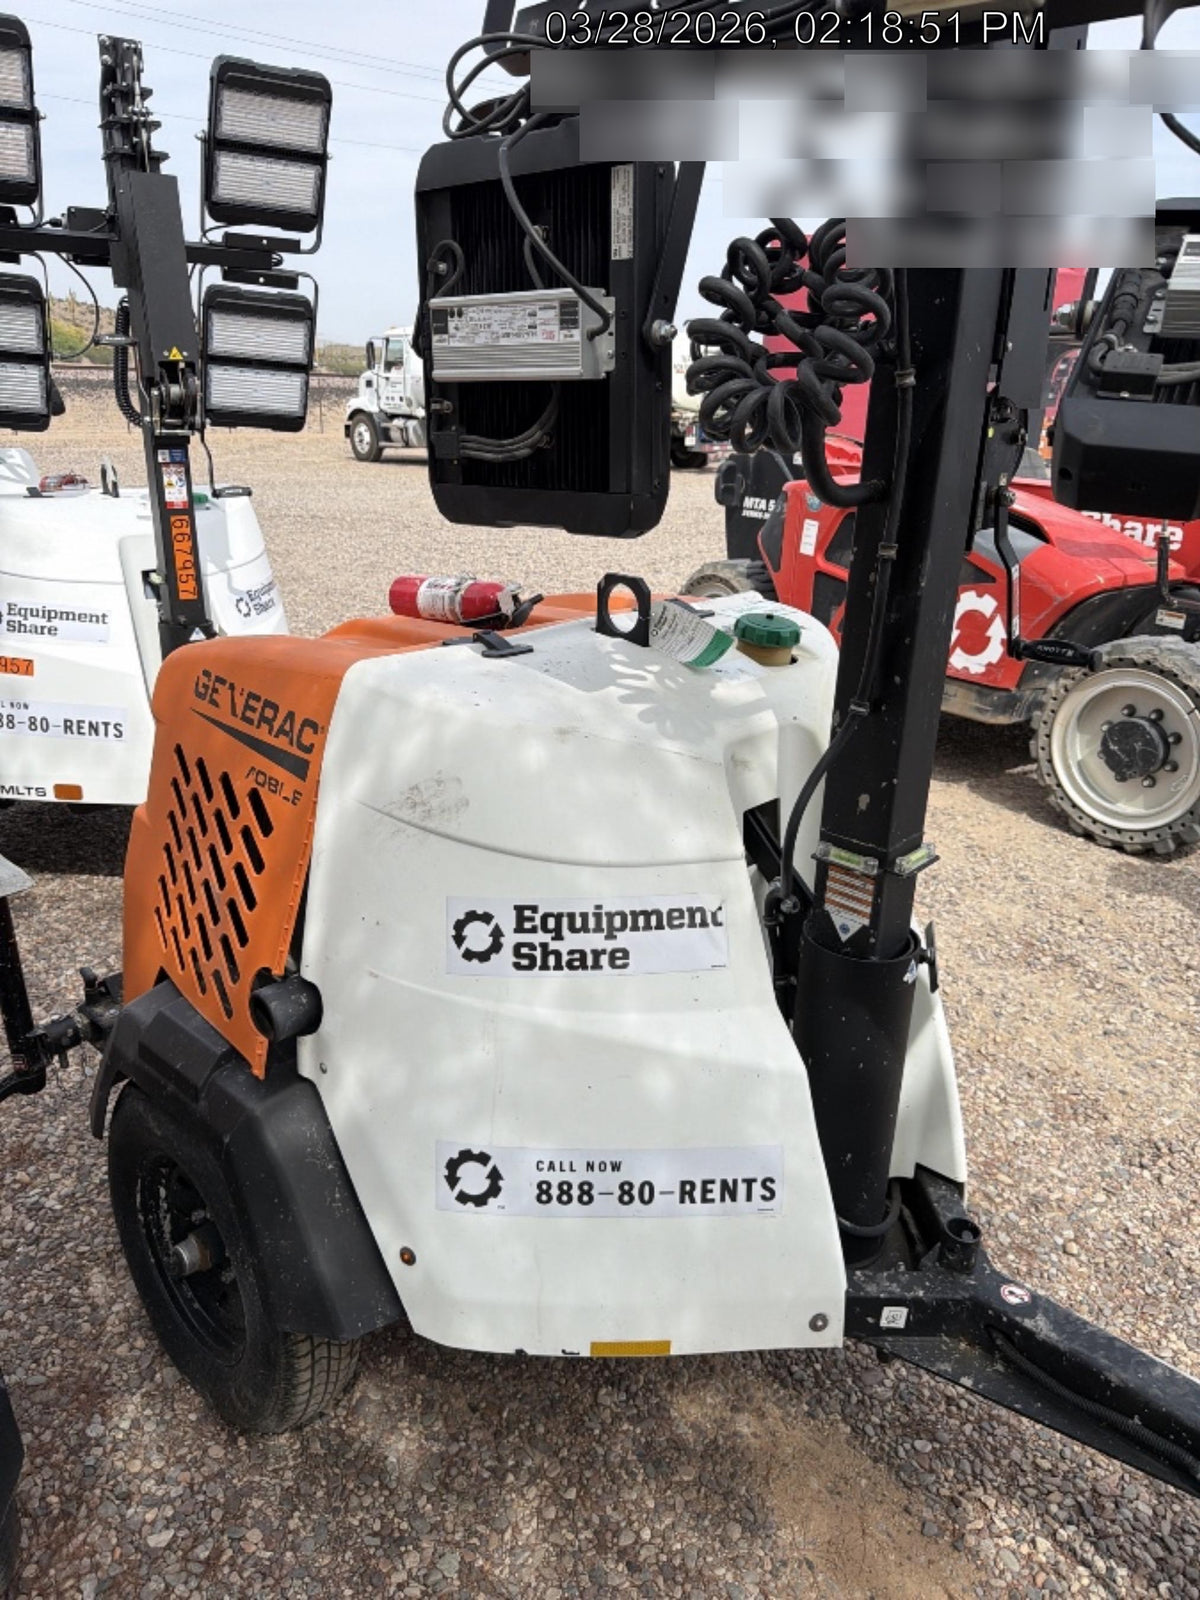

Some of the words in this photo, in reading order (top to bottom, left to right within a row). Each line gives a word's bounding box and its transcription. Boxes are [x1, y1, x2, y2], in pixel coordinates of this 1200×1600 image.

[743, 496, 767, 511] MTA
[172, 517, 198, 598] 667957
[6, 602, 109, 625] Equipment
[6, 620, 58, 636] Share
[511, 941, 630, 972] Share
[535, 1160, 577, 1173] CALL
[585, 1160, 623, 1173] NOW
[535, 1176, 777, 1207] 888-80-RENTS
